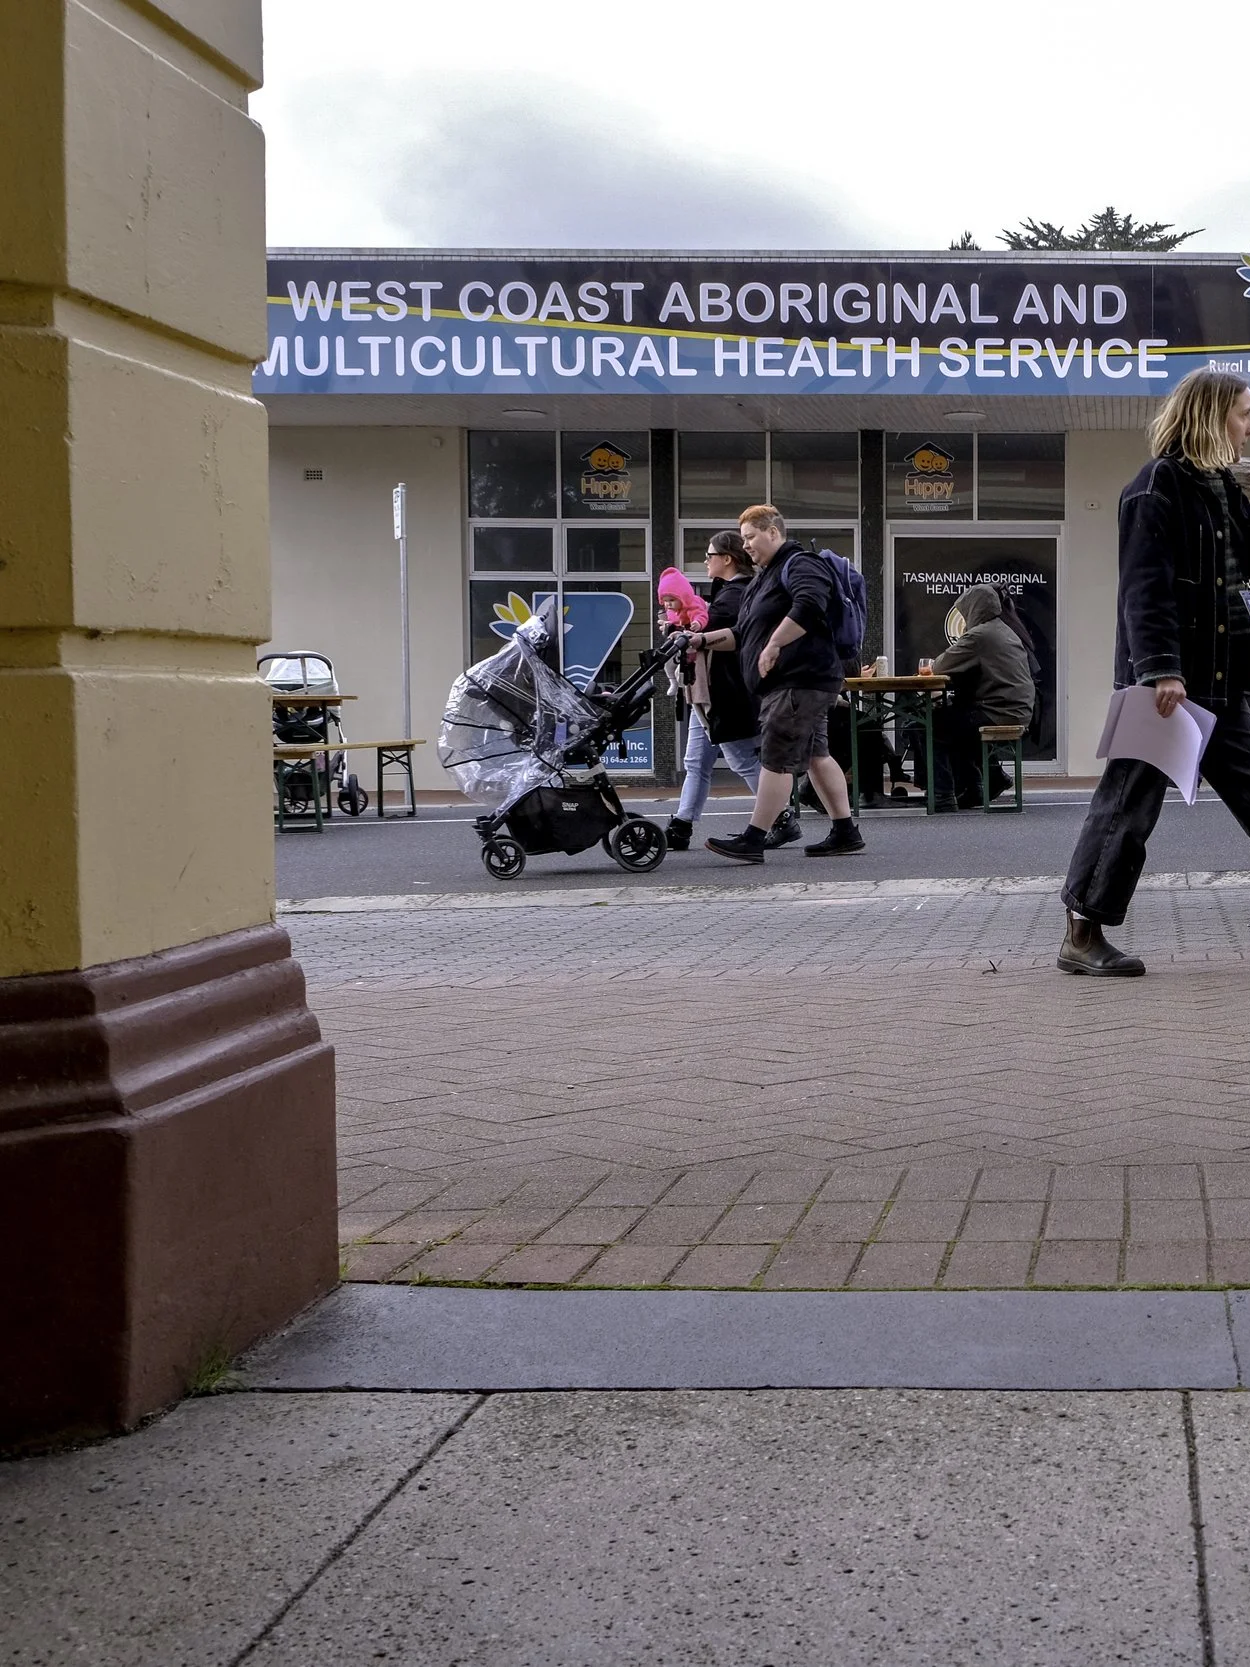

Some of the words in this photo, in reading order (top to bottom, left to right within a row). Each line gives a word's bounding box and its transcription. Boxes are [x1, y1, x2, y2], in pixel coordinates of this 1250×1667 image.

[287, 281, 443, 322] WEST
[459, 281, 644, 323] COAST
[659, 282, 998, 324] ABORIGINAL
[1013, 283, 1127, 325] AND
[252, 335, 697, 377] MULTICULTURAL
[714, 336, 919, 378] HEALTH
[939, 337, 1168, 379] SERVICE
[1209, 359, 1243, 374] Rural
[581, 478, 632, 499] Hippy
[905, 478, 955, 500] Hippy
[903, 572, 972, 583] TASMANIAN
[975, 573, 1047, 584] ABORIGINAL
[926, 584, 972, 594] HEALTH
[627, 740, 648, 751] Inc.
[630, 756, 648, 764] 1266
